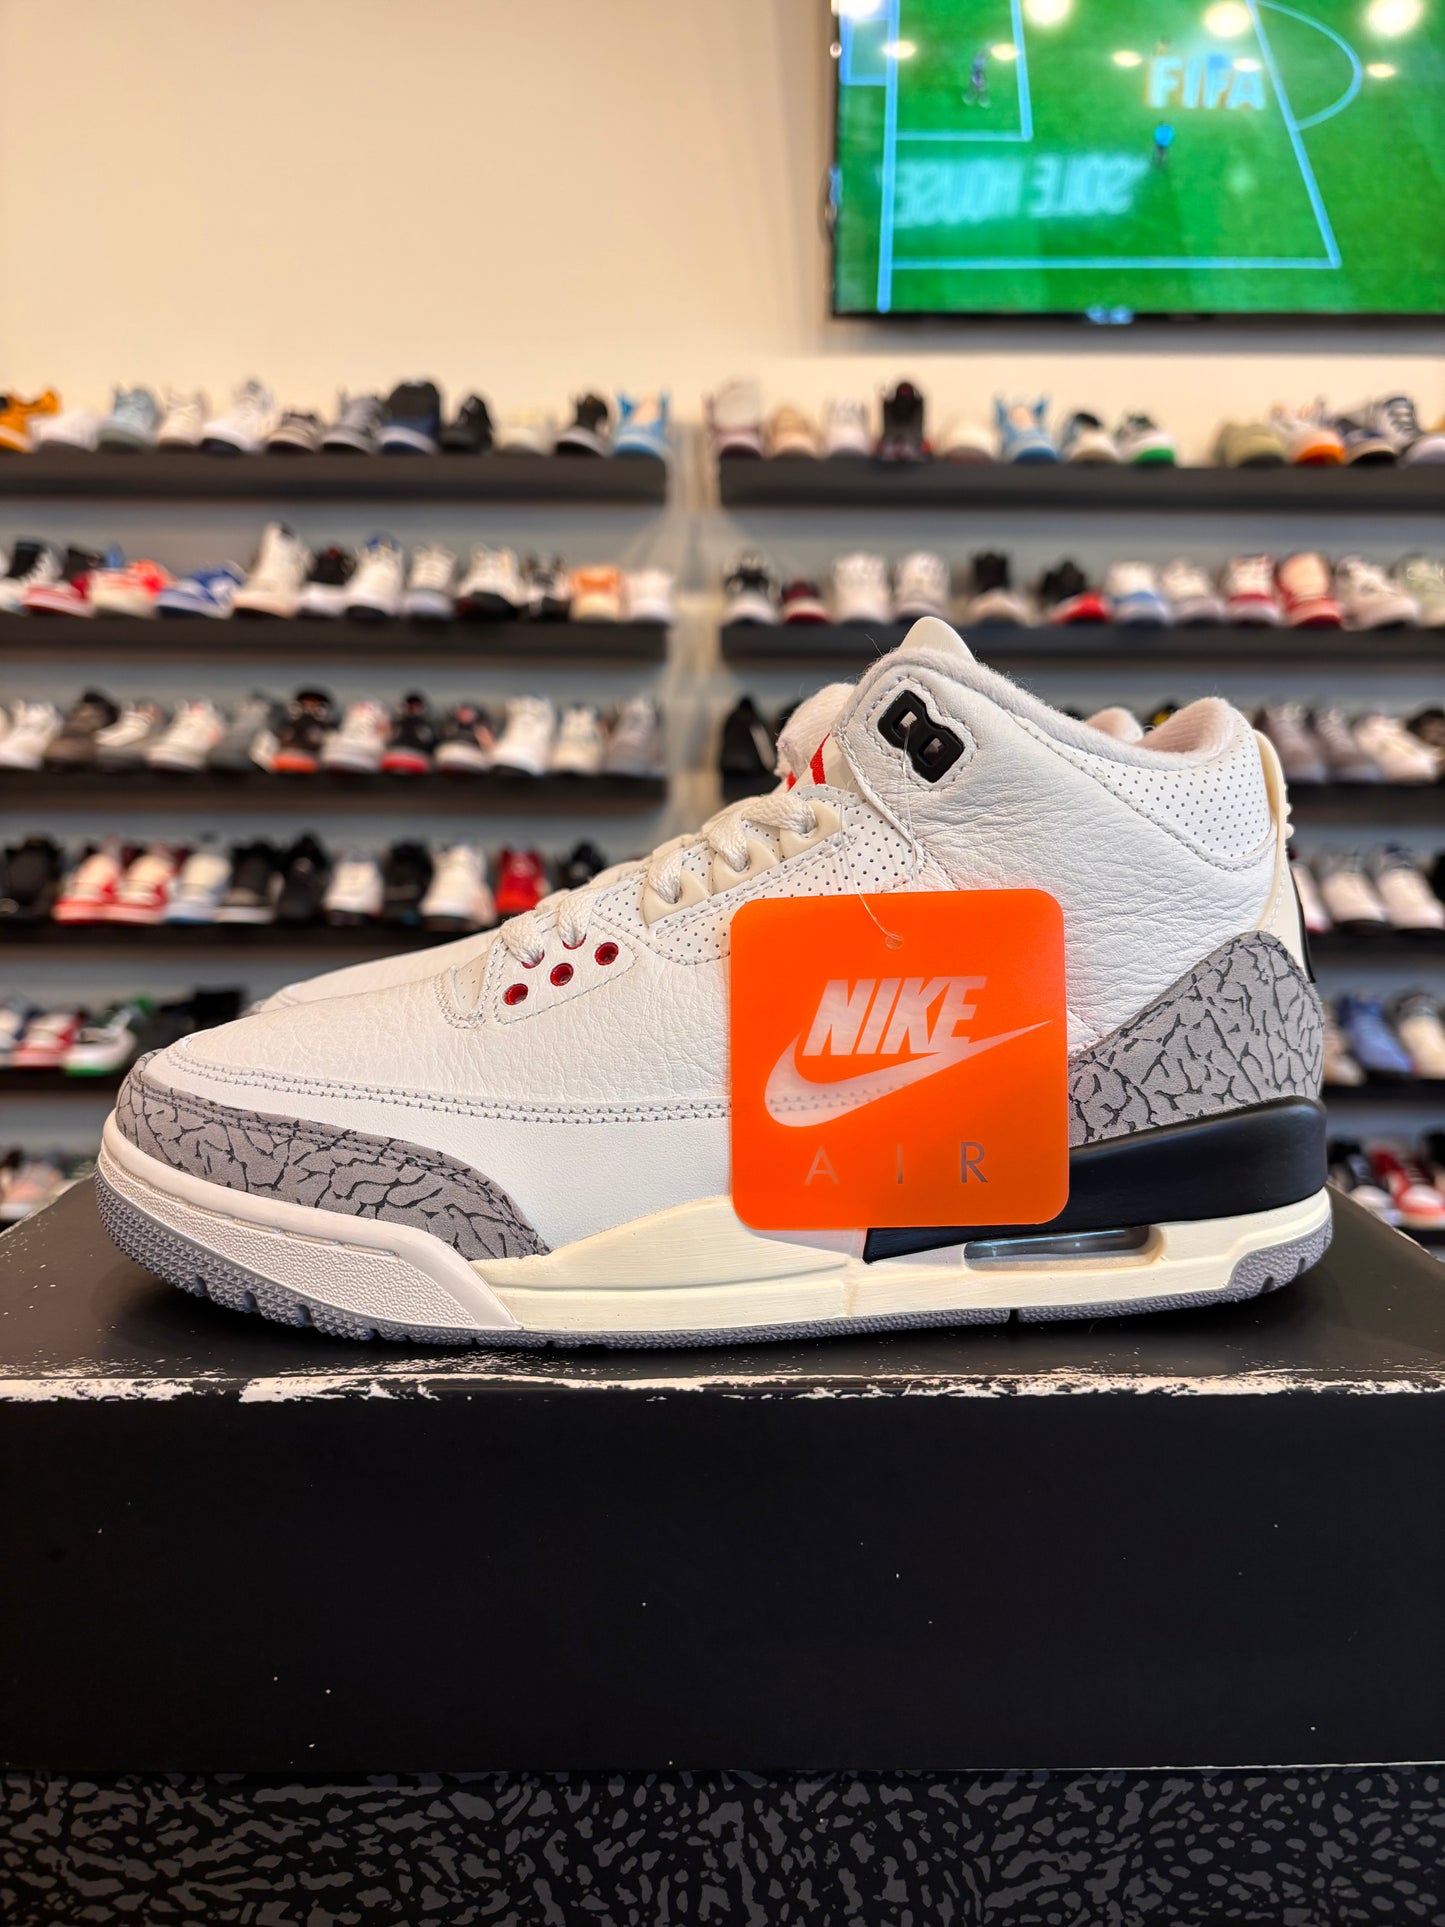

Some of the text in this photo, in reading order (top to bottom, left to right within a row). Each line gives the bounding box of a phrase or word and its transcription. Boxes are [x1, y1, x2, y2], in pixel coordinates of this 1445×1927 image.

[1145, 56, 1266, 109] FIFA
[803, 976, 987, 1056] NIKE
[804, 1141, 988, 1185] AIR
